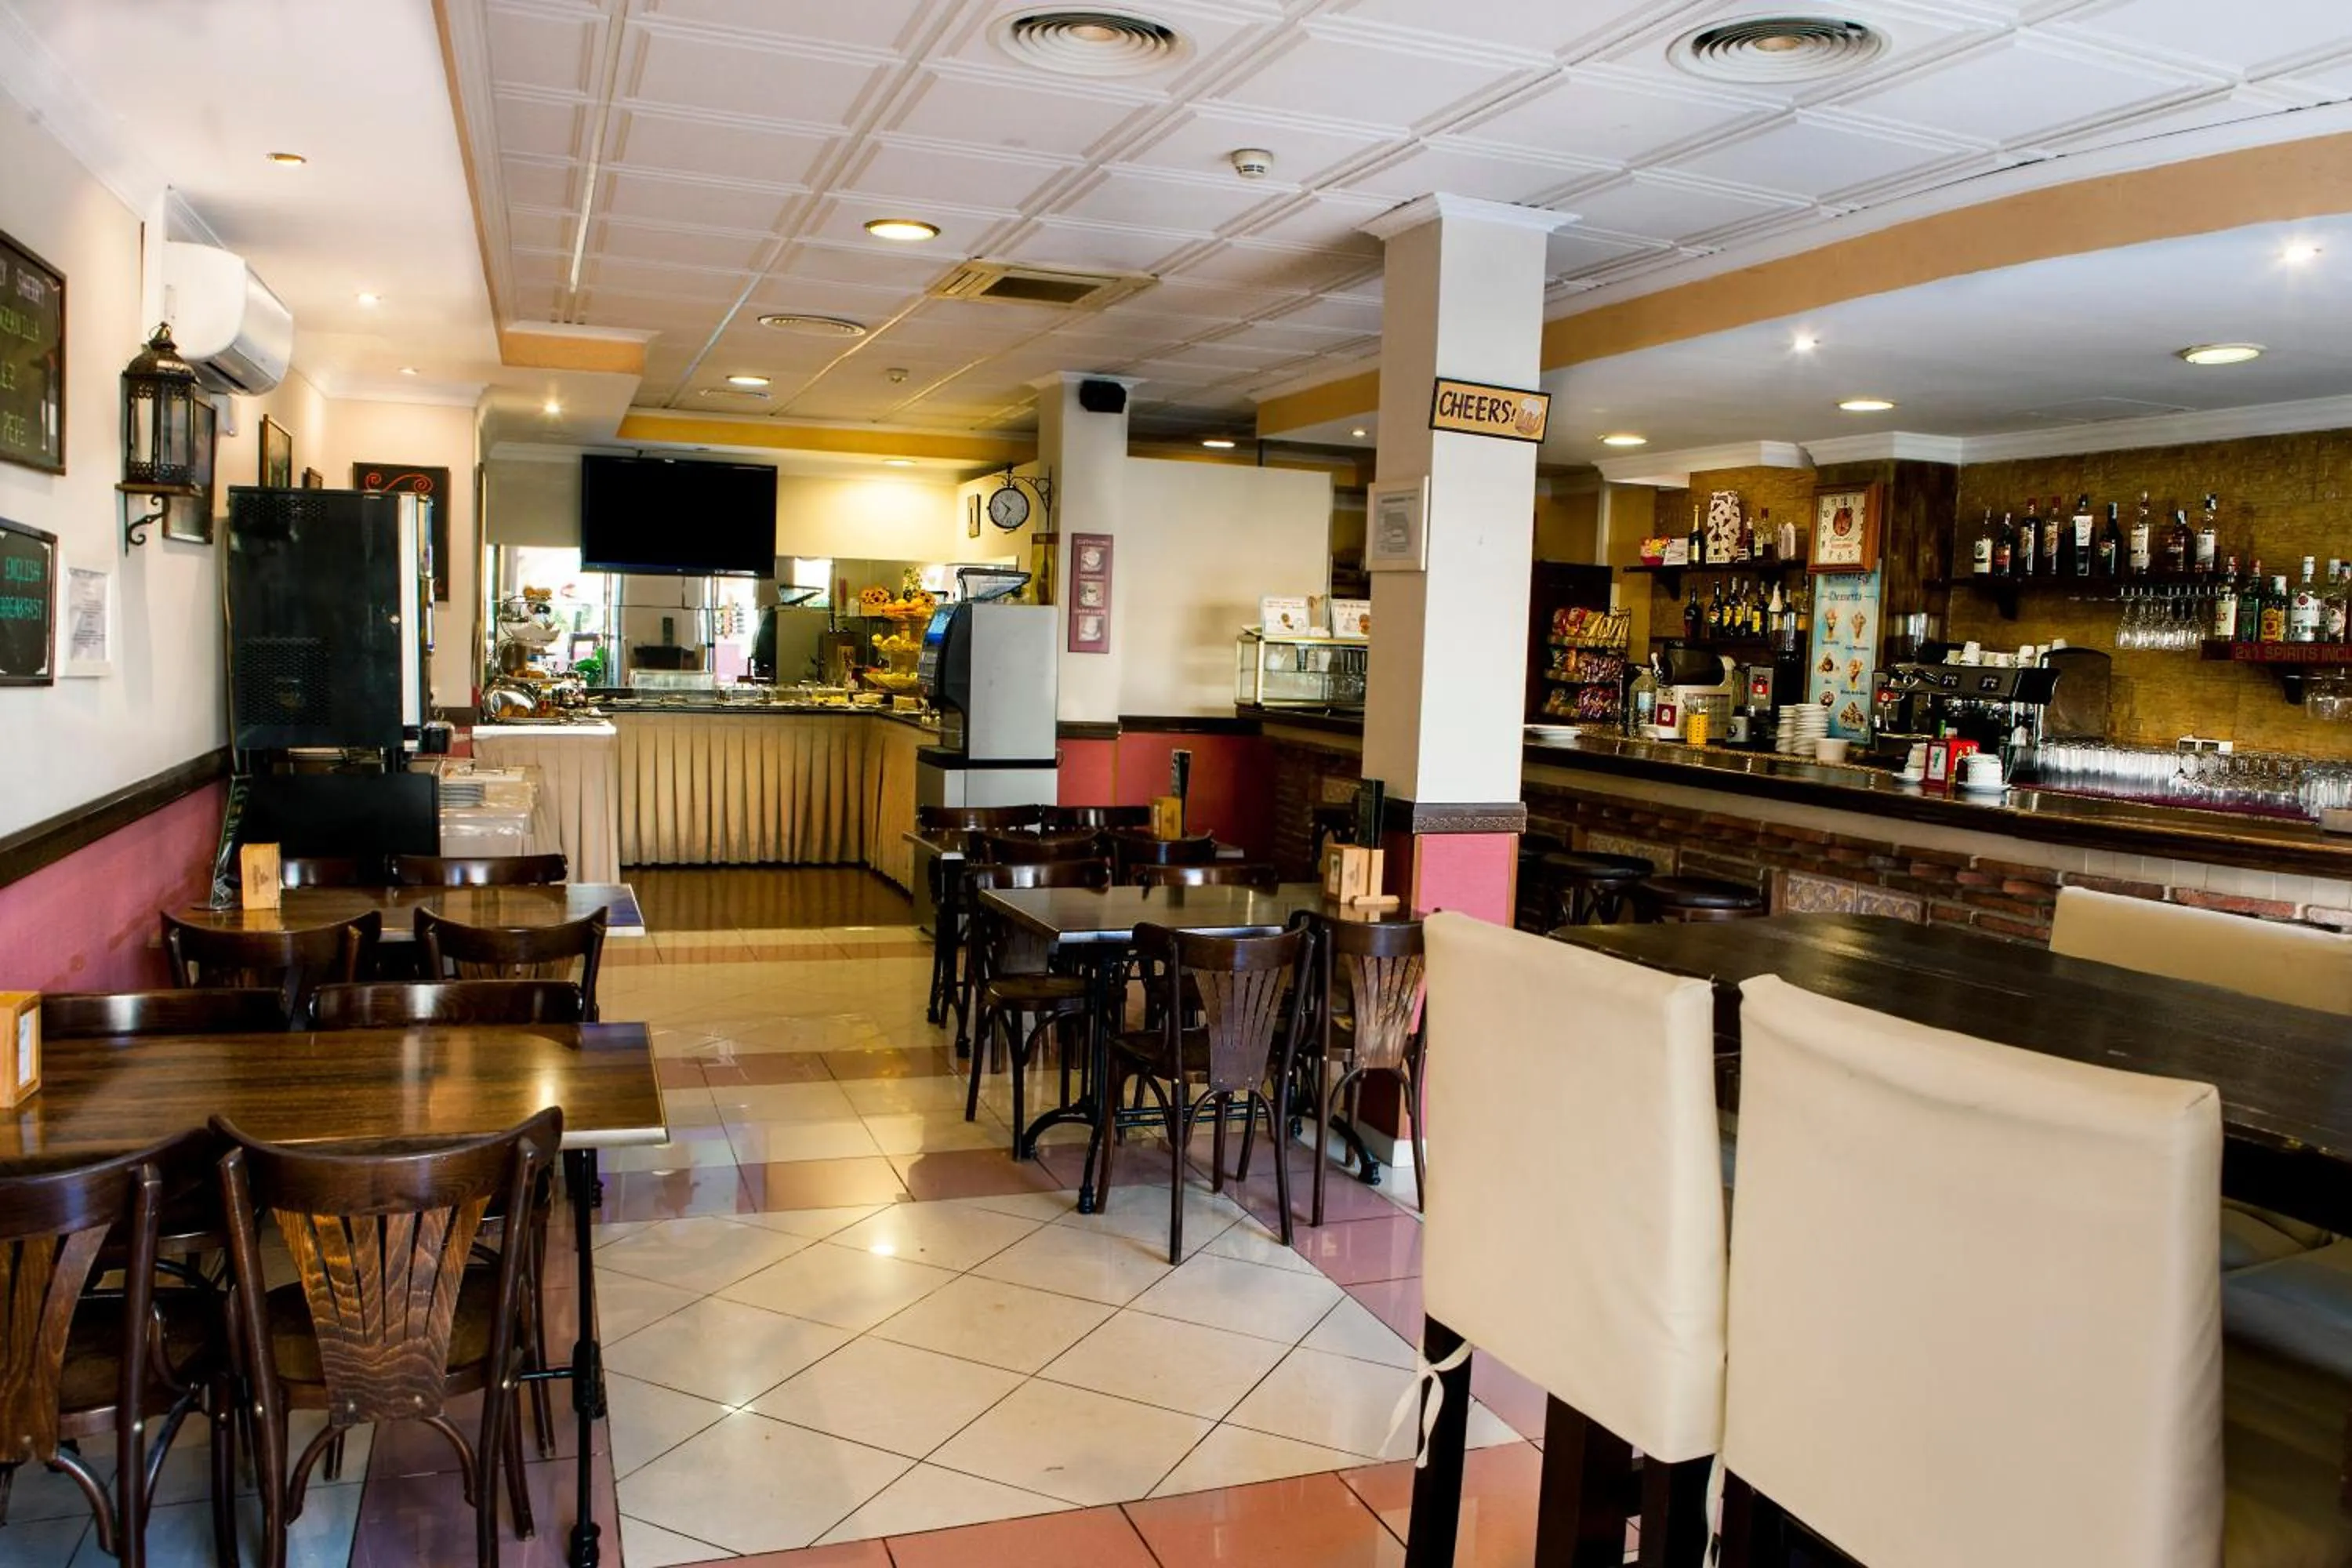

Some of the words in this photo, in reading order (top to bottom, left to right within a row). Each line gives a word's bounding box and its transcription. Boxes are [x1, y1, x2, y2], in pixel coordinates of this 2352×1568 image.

[1439, 390, 1516, 424] CHEERS!
[2265, 645, 2318, 662] SPIRITS
[2321, 646, 2352, 662] INCL
